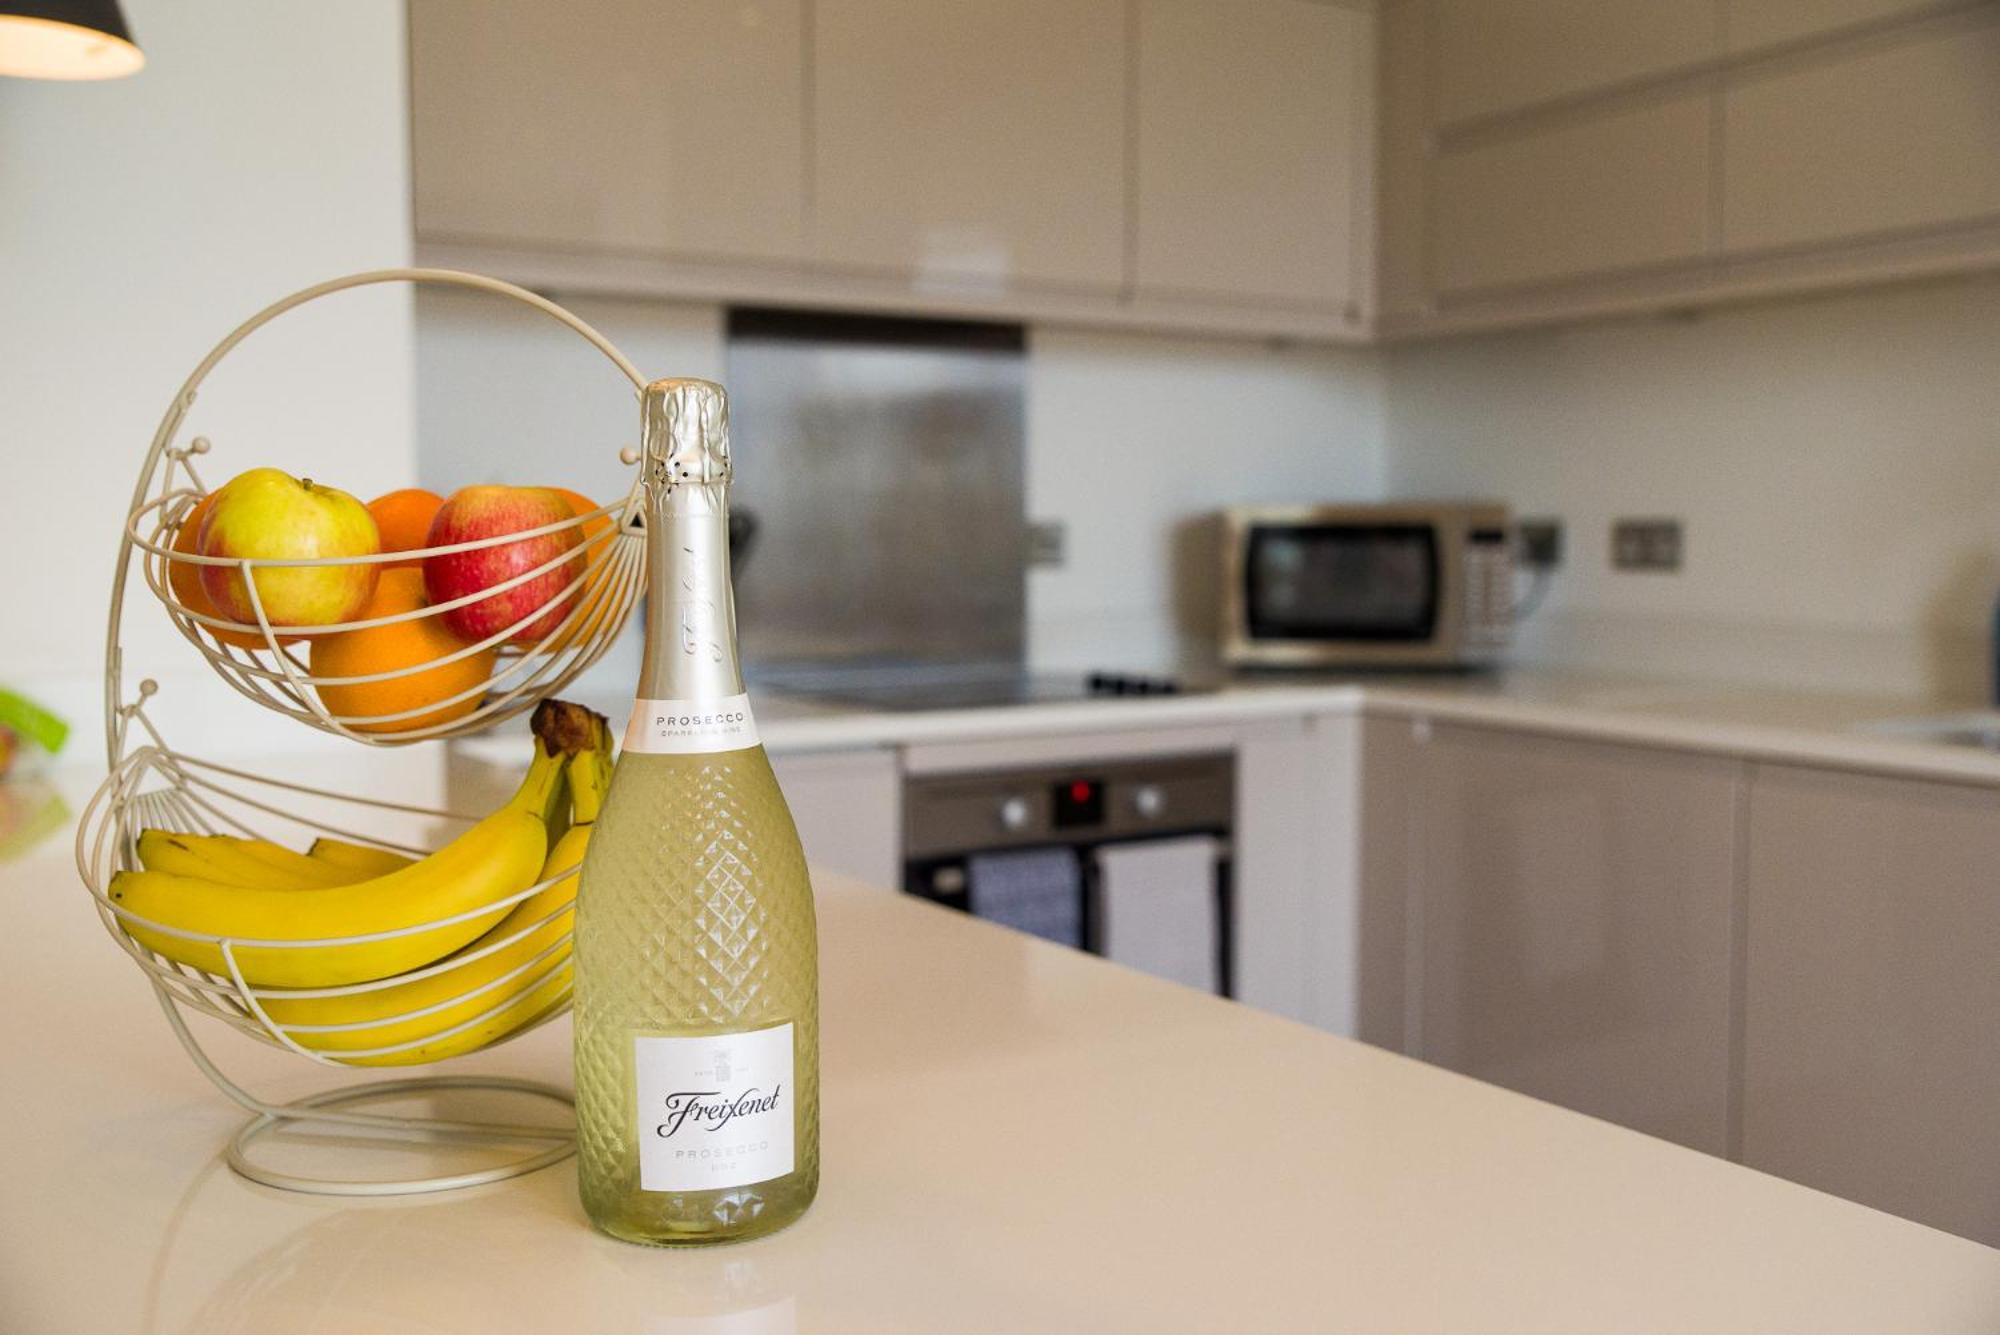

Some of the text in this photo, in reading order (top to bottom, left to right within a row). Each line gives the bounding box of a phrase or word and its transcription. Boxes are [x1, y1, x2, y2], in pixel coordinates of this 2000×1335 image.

[656, 711, 744, 726] PROSECCO
[656, 1084, 781, 1138] Freixenet
[675, 1141, 769, 1159] PROSECCO
